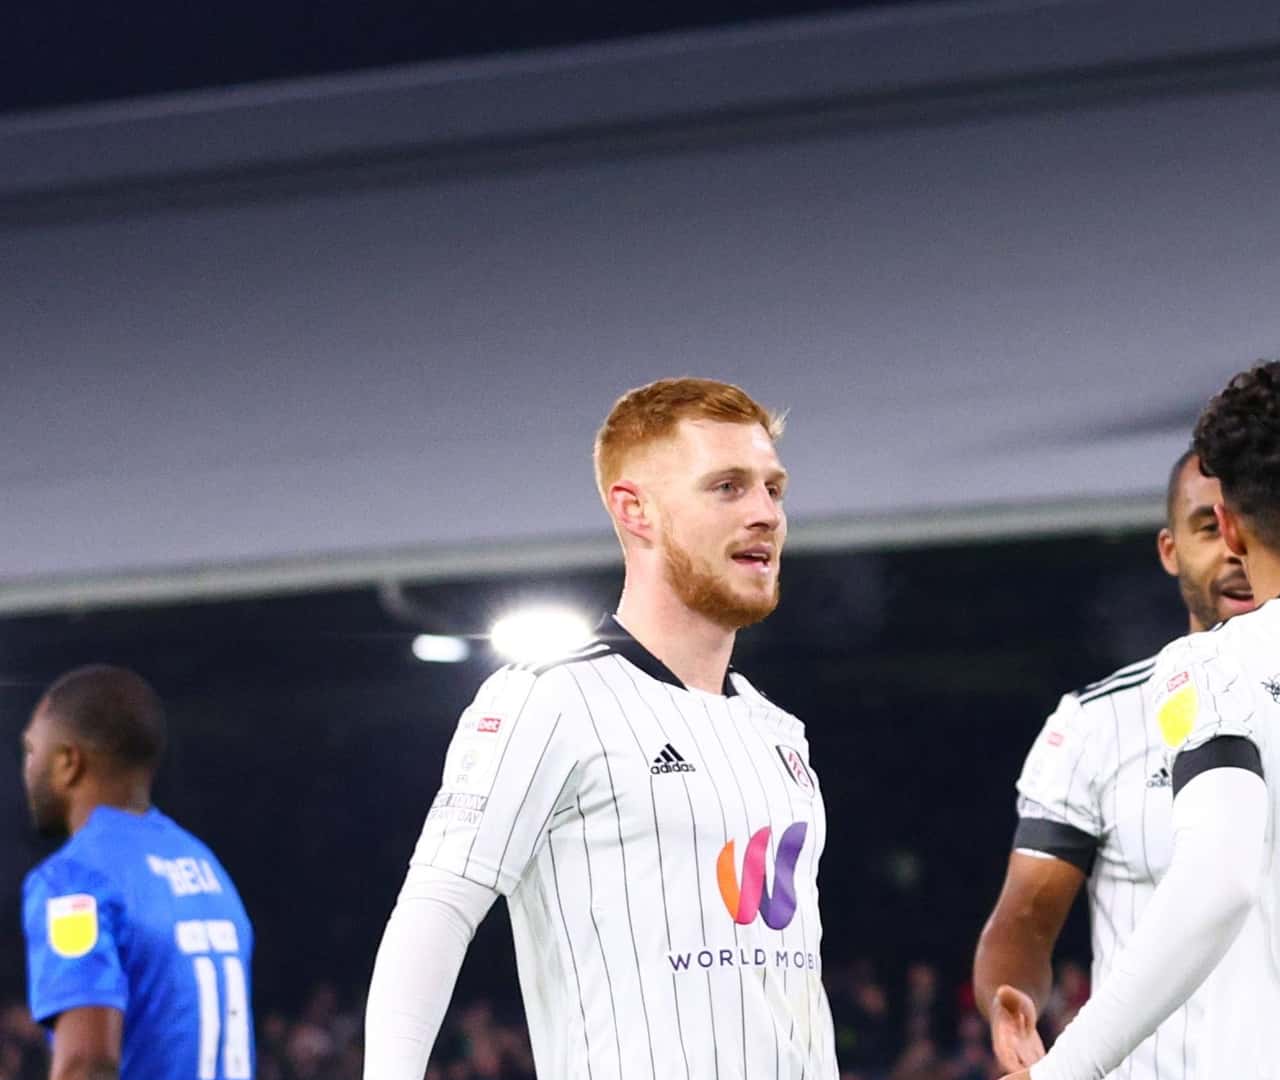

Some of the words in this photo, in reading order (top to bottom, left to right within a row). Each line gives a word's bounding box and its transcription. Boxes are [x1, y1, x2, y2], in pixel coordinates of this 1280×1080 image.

[650, 762, 696, 775] adidas
[668, 948, 767, 972] WORLD
[776, 951, 815, 970] MOB
